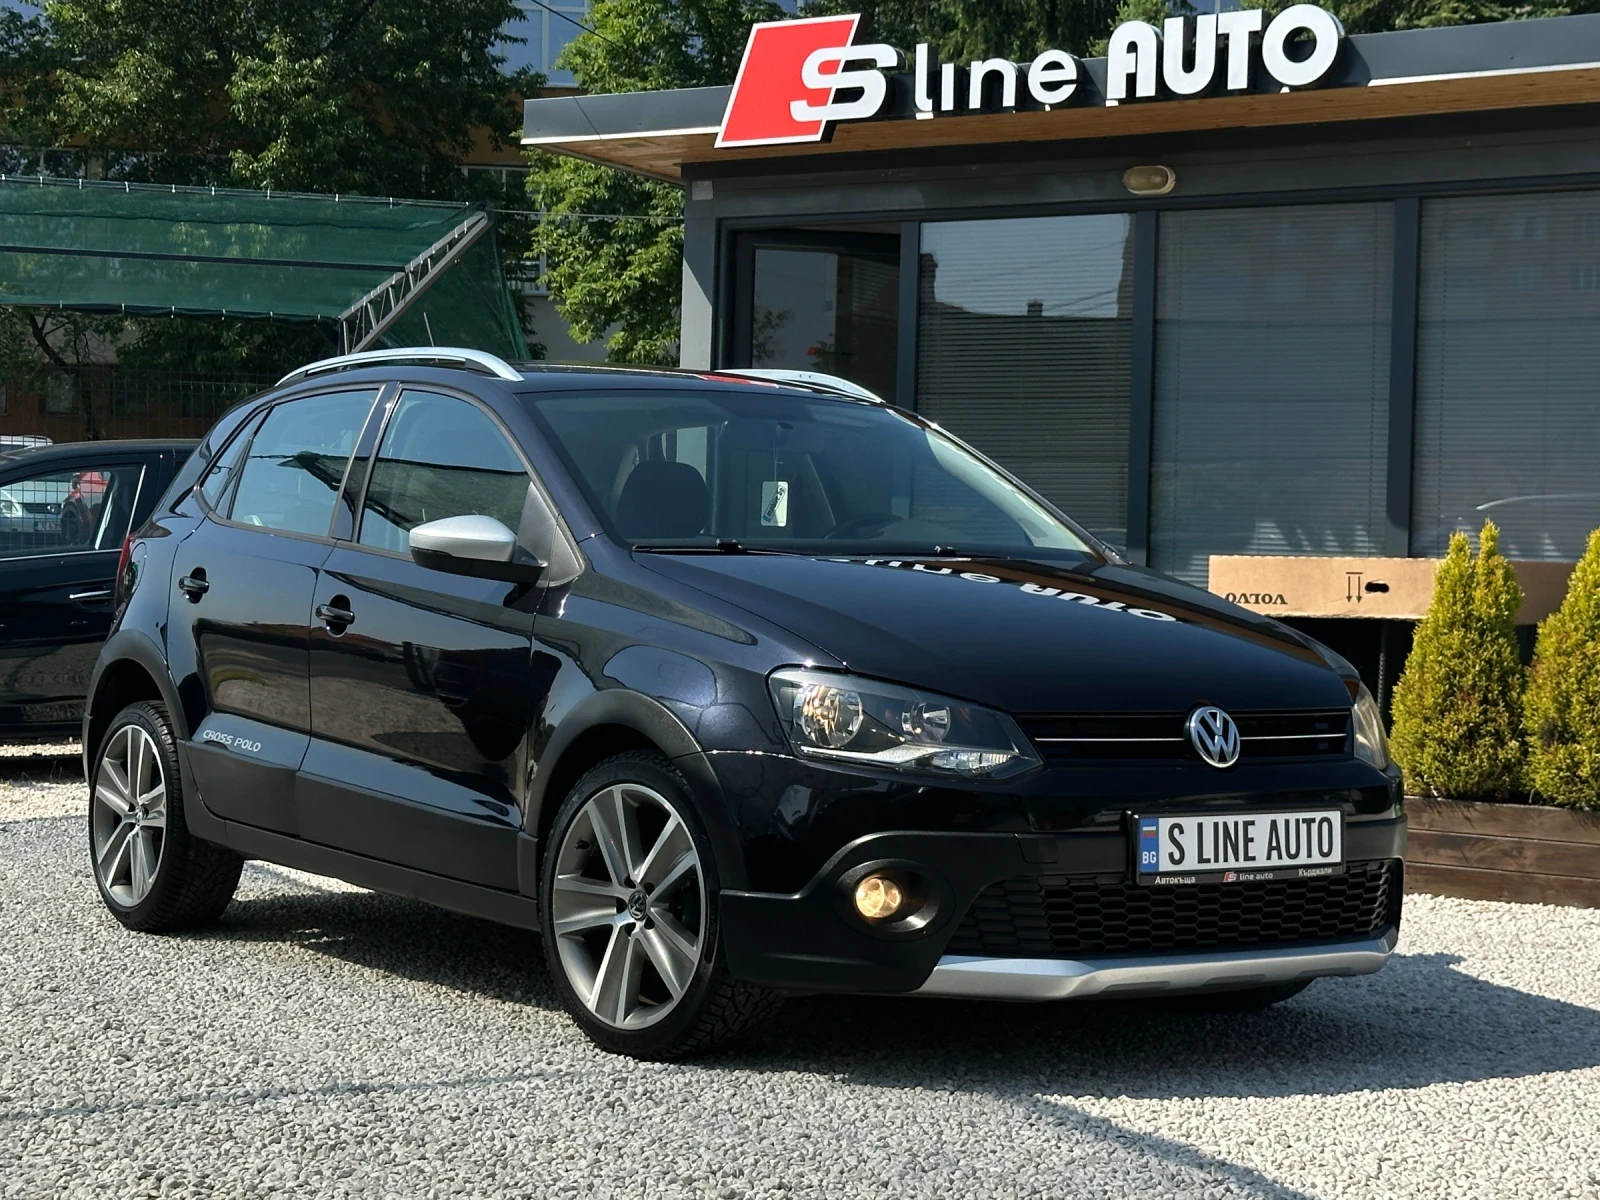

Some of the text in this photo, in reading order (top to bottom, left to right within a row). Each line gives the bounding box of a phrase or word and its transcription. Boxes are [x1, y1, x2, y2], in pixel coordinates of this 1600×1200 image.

[789, 4, 1341, 122] S line AUTO
[1225, 592, 1288, 605] VOLVO
[203, 730, 261, 752] CROSS POLO
[1168, 816, 1334, 866] S LINE AUTO
[1142, 851, 1157, 864] BG
[1239, 872, 1255, 881] line
[1256, 871, 1274, 880] auto
[1298, 866, 1332, 877] Кърджали
[1154, 875, 1196, 885] Автокъща
